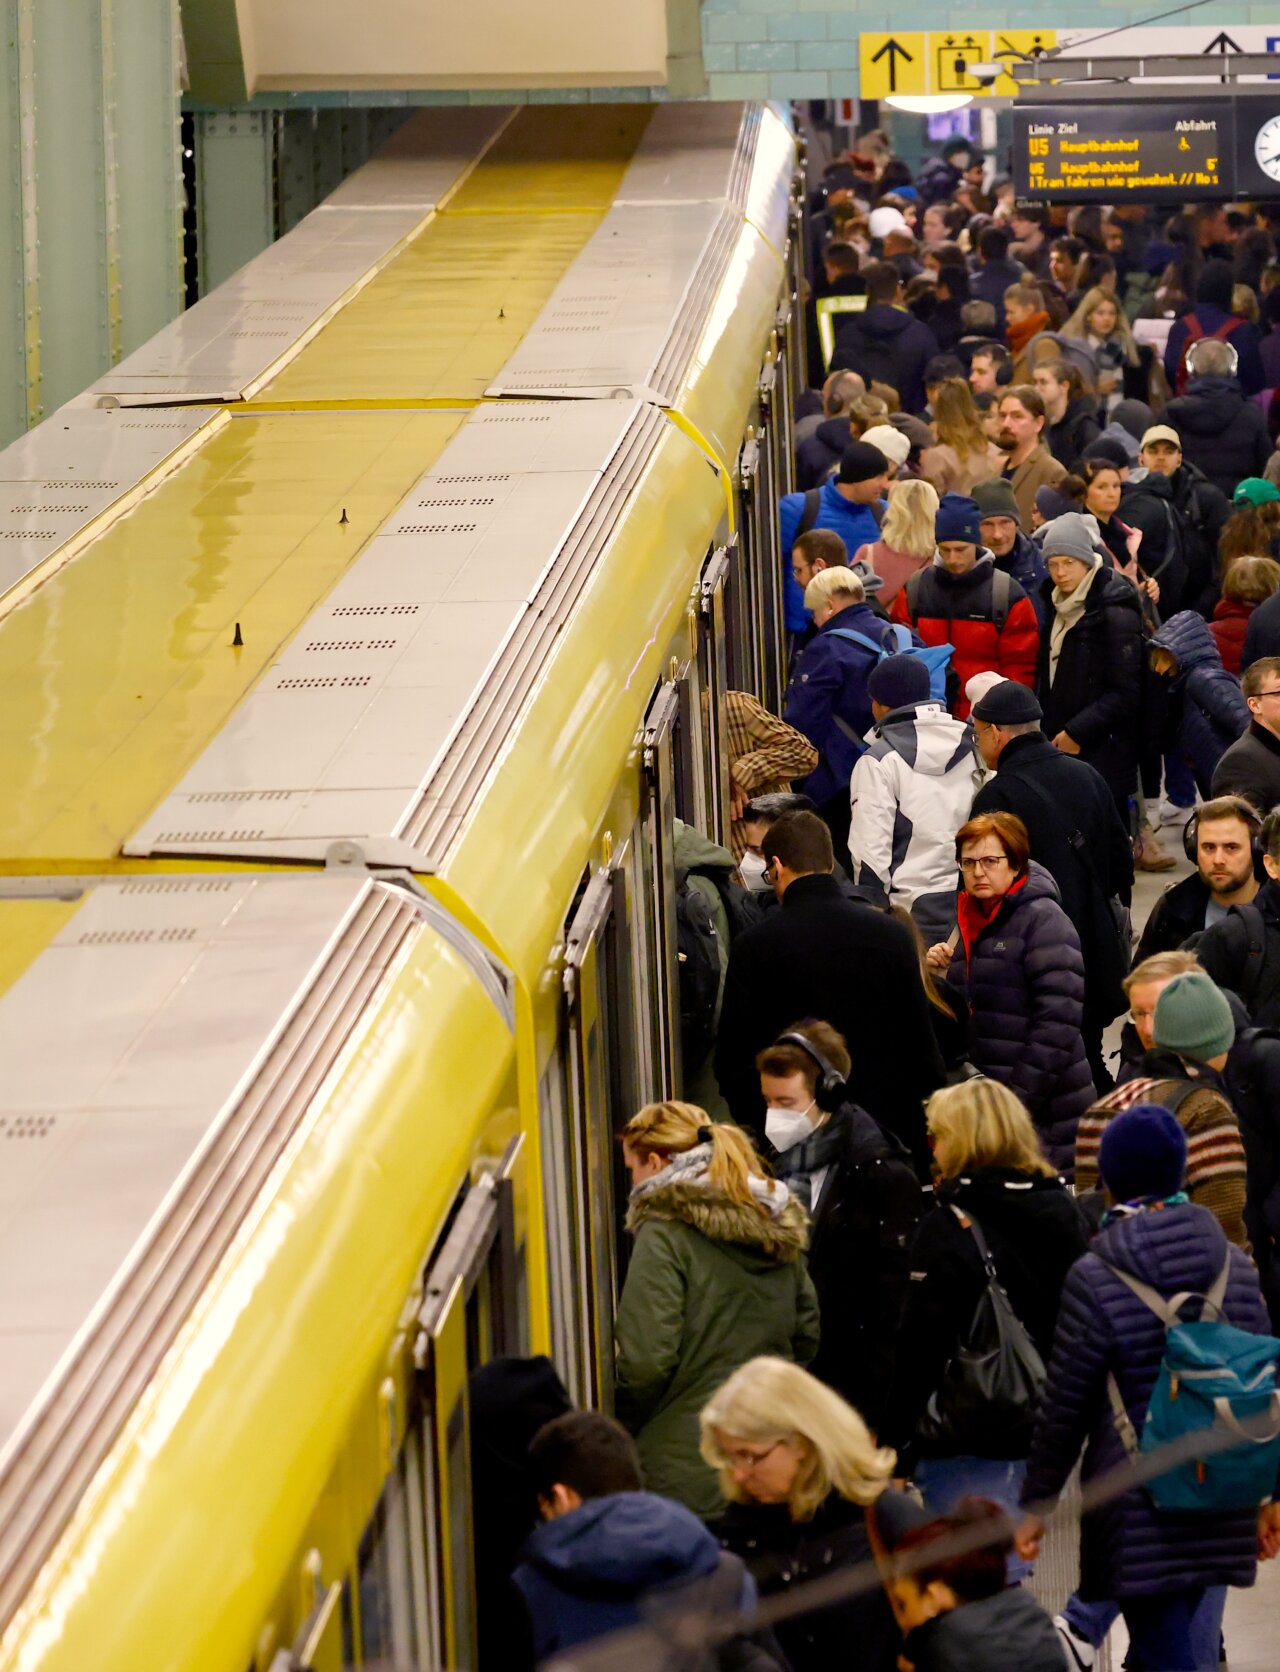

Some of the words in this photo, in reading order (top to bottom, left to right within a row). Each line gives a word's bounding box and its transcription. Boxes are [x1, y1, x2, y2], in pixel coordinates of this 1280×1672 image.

[1027, 124, 1054, 135] Linie
[1057, 122, 1078, 134] Ziel
[1175, 120, 1217, 132] Abfahrt
[1028, 137, 1049, 156] U5
[1059, 139, 1139, 154] Hauptbahnhof
[1059, 161, 1139, 175] Hauptbahnhof
